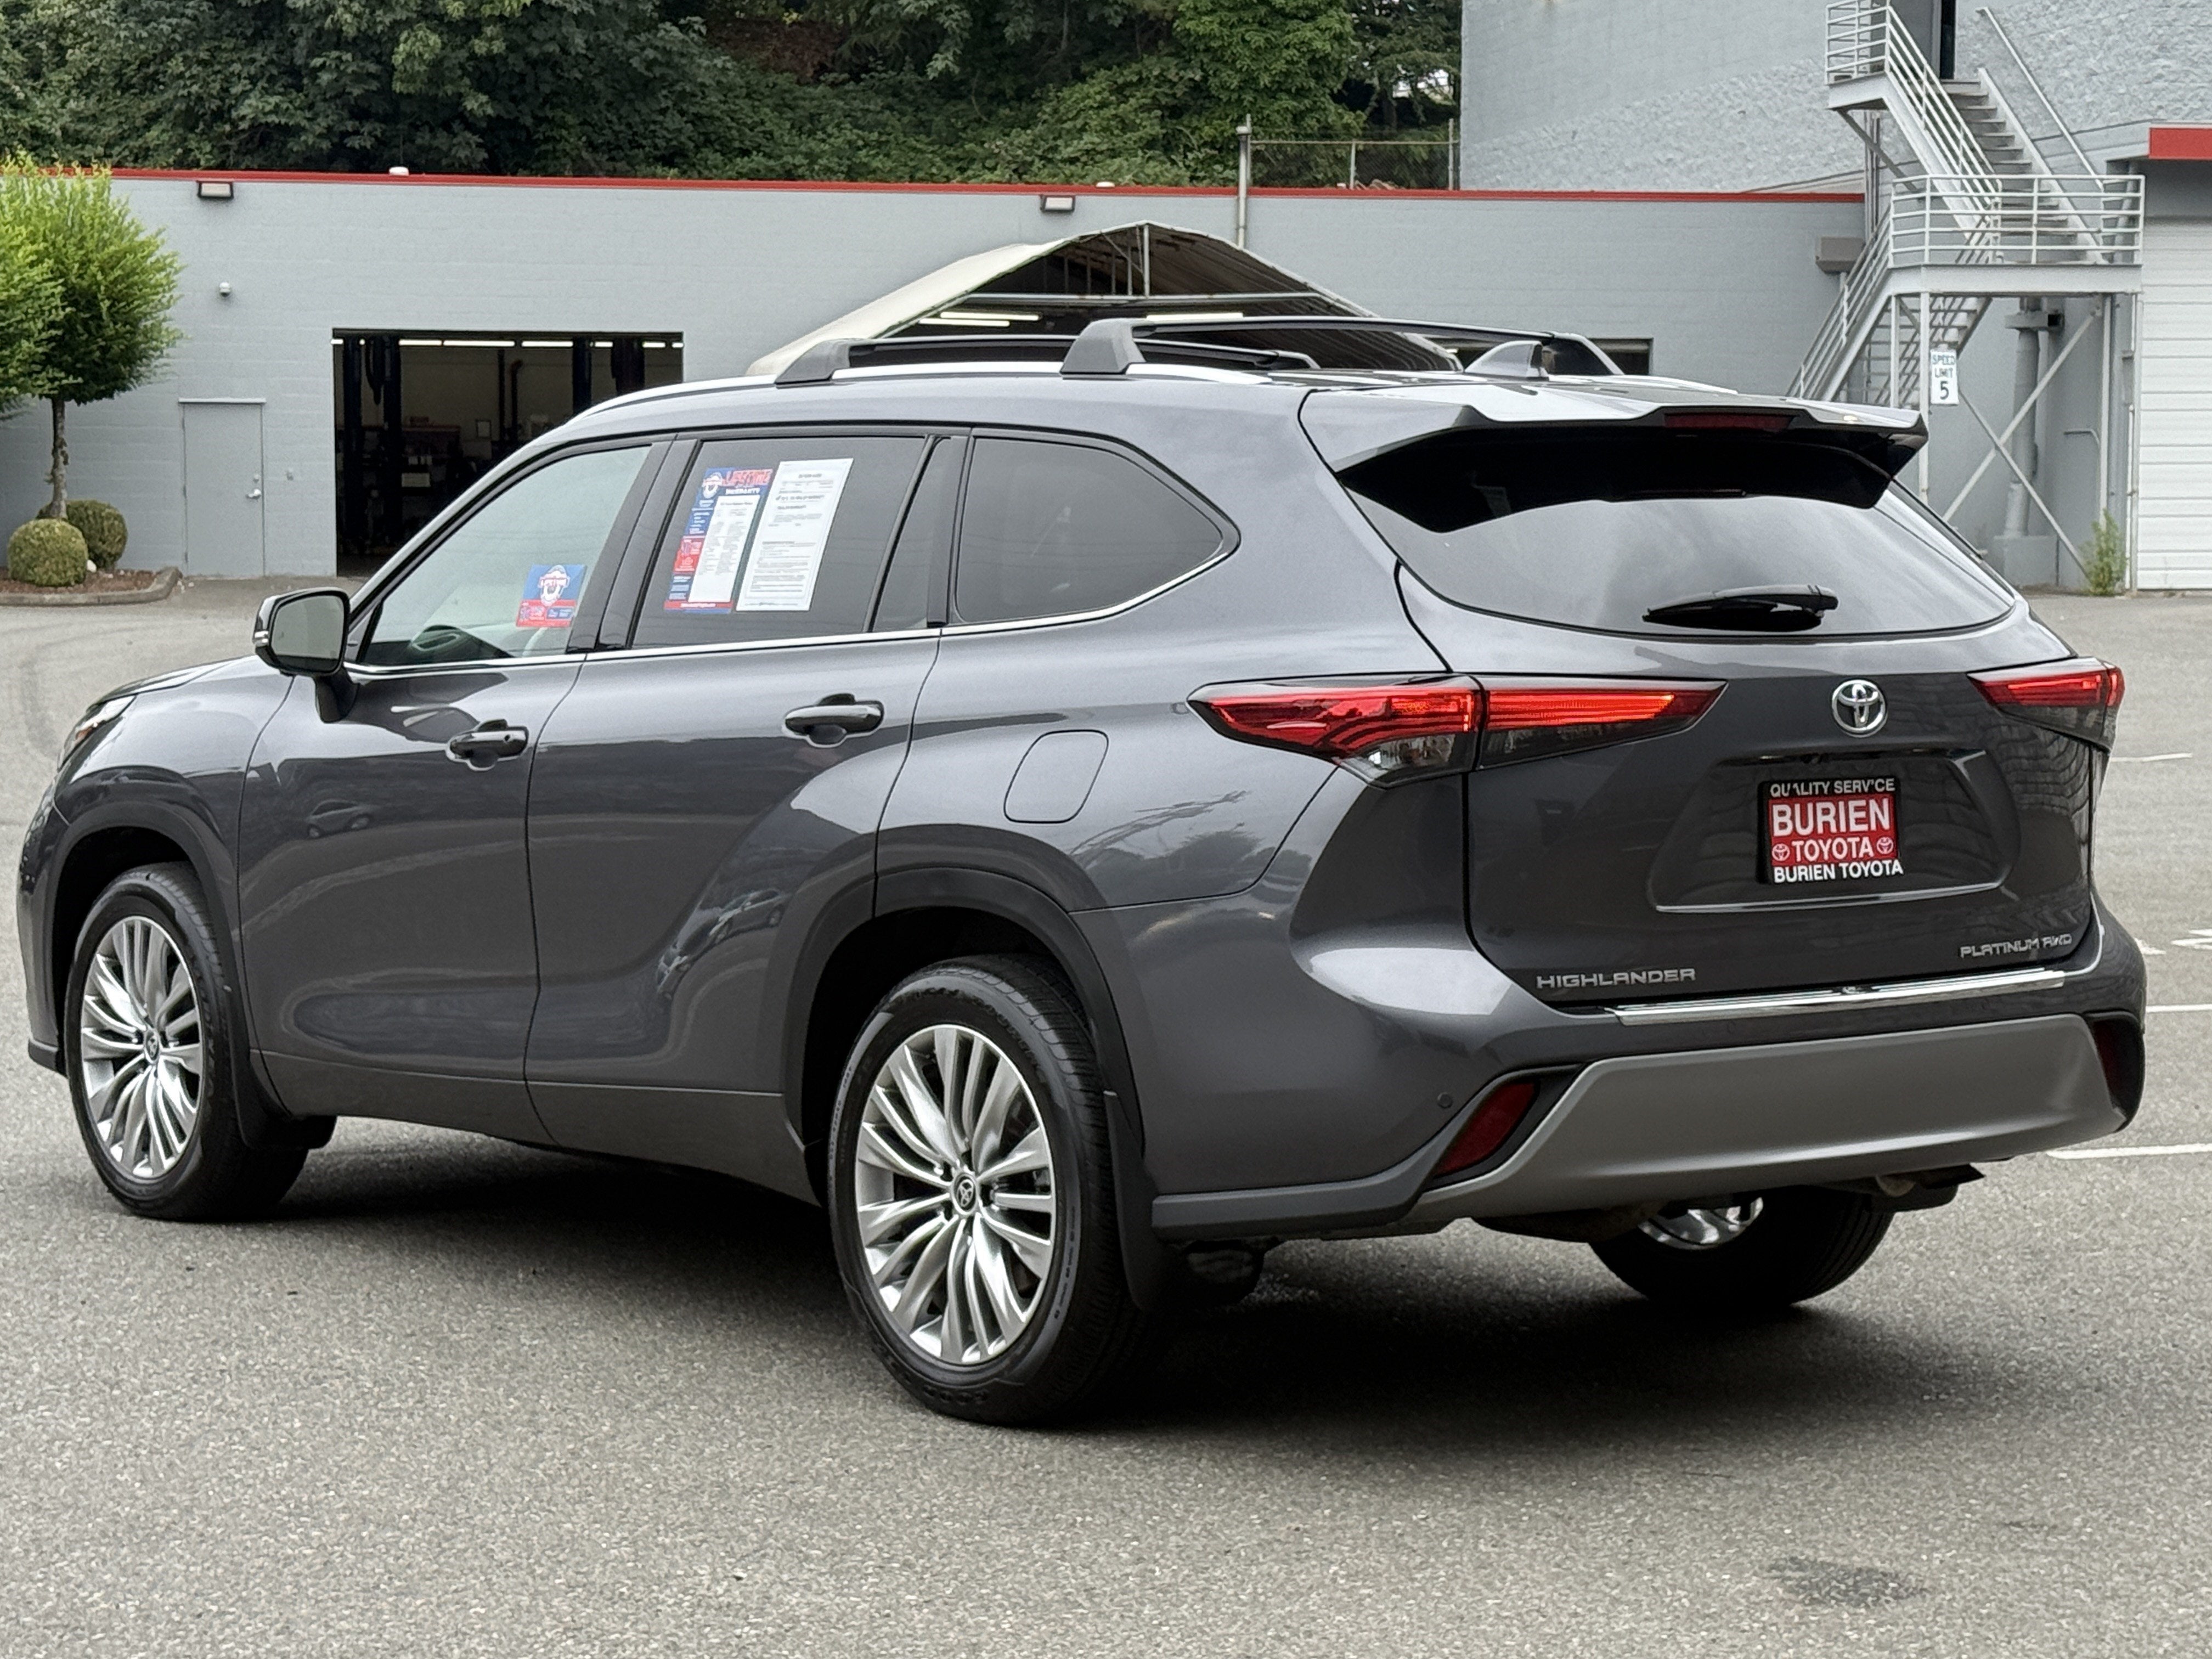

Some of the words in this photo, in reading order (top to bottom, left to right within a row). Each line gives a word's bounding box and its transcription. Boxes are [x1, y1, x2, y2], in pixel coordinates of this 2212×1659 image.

[1932, 354, 1955, 365] SPEED
[1934, 368, 1953, 378] LIMIT
[1940, 380, 1949, 400] 5
[1772, 798, 1891, 837] BURIEN
[1791, 837, 1875, 862] TOYOTA
[1774, 864, 1836, 883] BURIEN
[1839, 859, 1904, 878] TOYOTA
[1960, 937, 2040, 958] PLATINUM
[2041, 933, 2073, 949] AWD
[1536, 968, 1696, 989] HIGHLANDER
